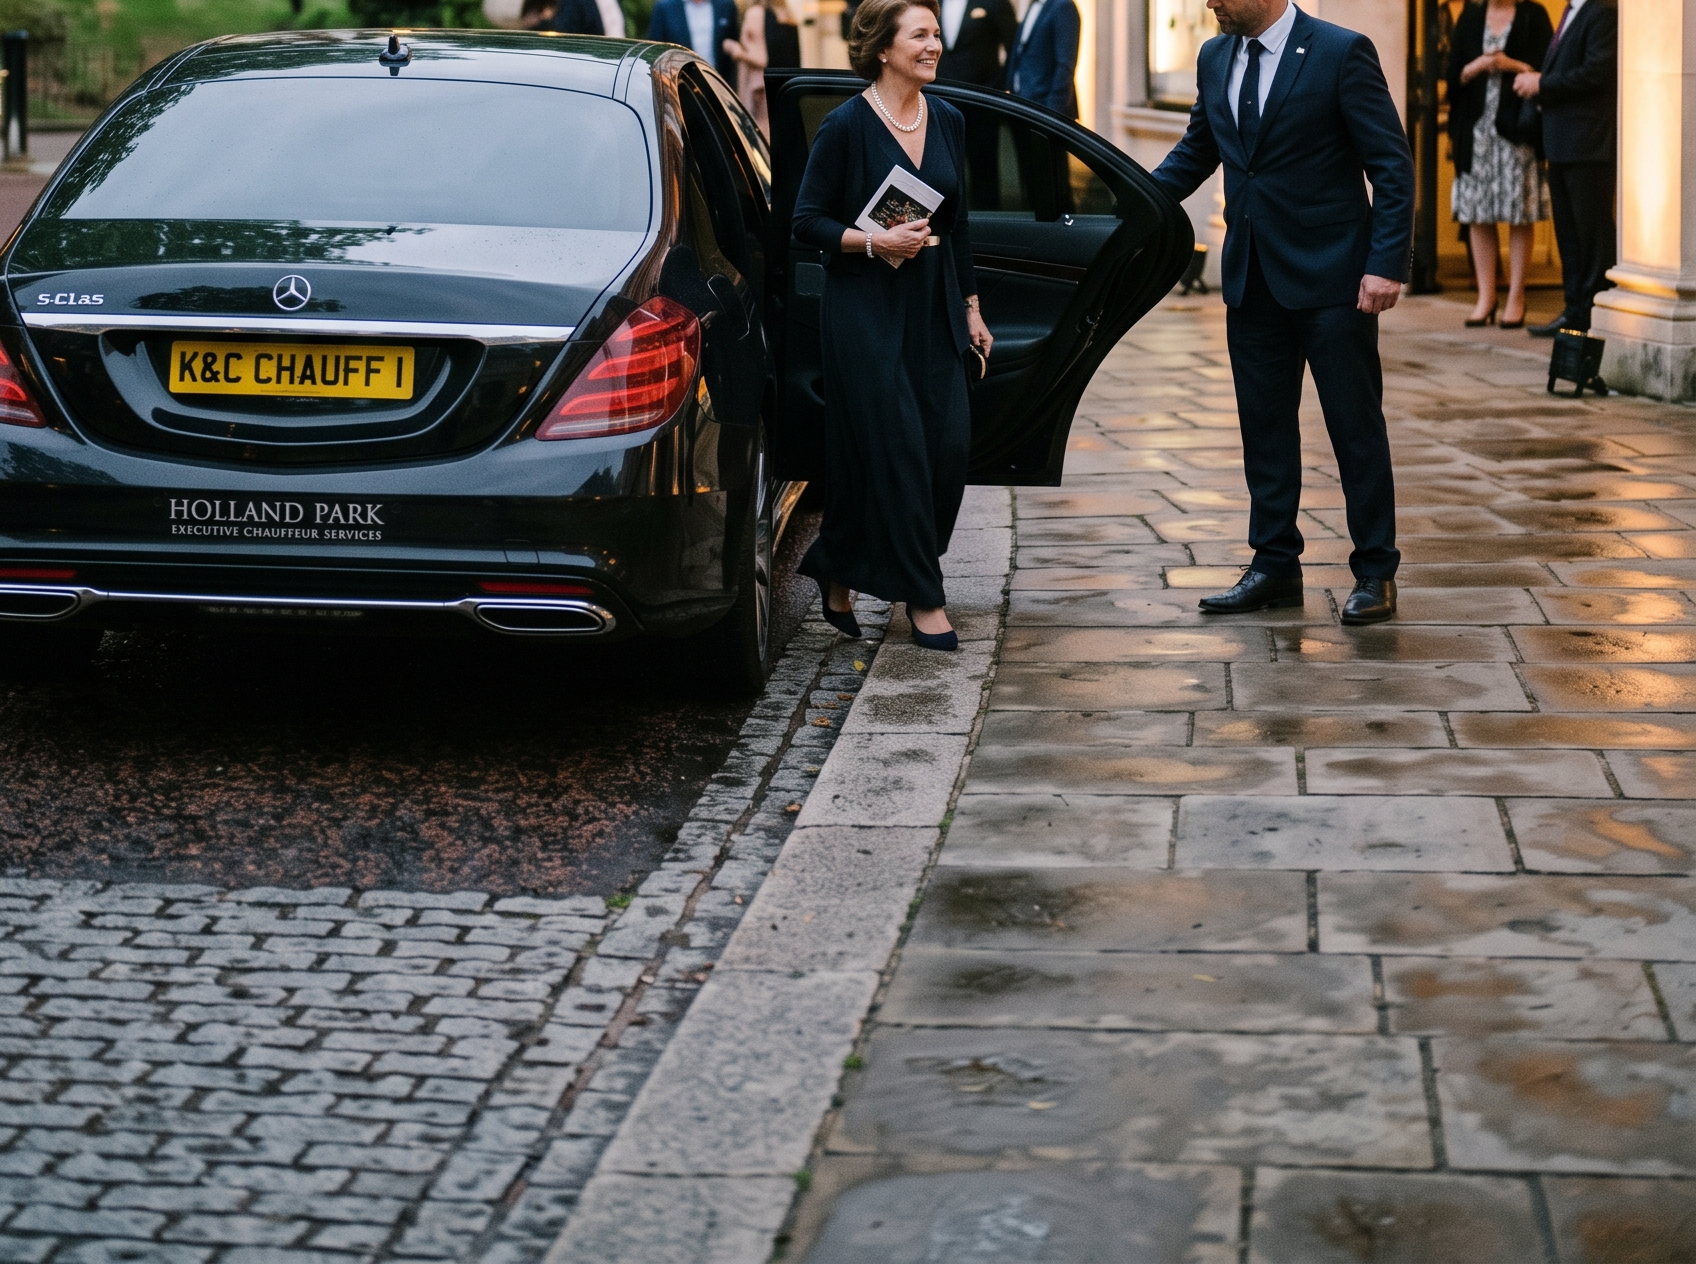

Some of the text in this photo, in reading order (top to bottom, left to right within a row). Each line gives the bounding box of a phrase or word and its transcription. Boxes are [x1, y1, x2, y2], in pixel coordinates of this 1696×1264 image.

[179, 351, 243, 383] K&C
[253, 353, 385, 387] CHAUFF
[169, 499, 385, 525] HOLLAND PARK
[171, 524, 382, 541] EXECUTIVE CHAUFFEUR SERVICES
